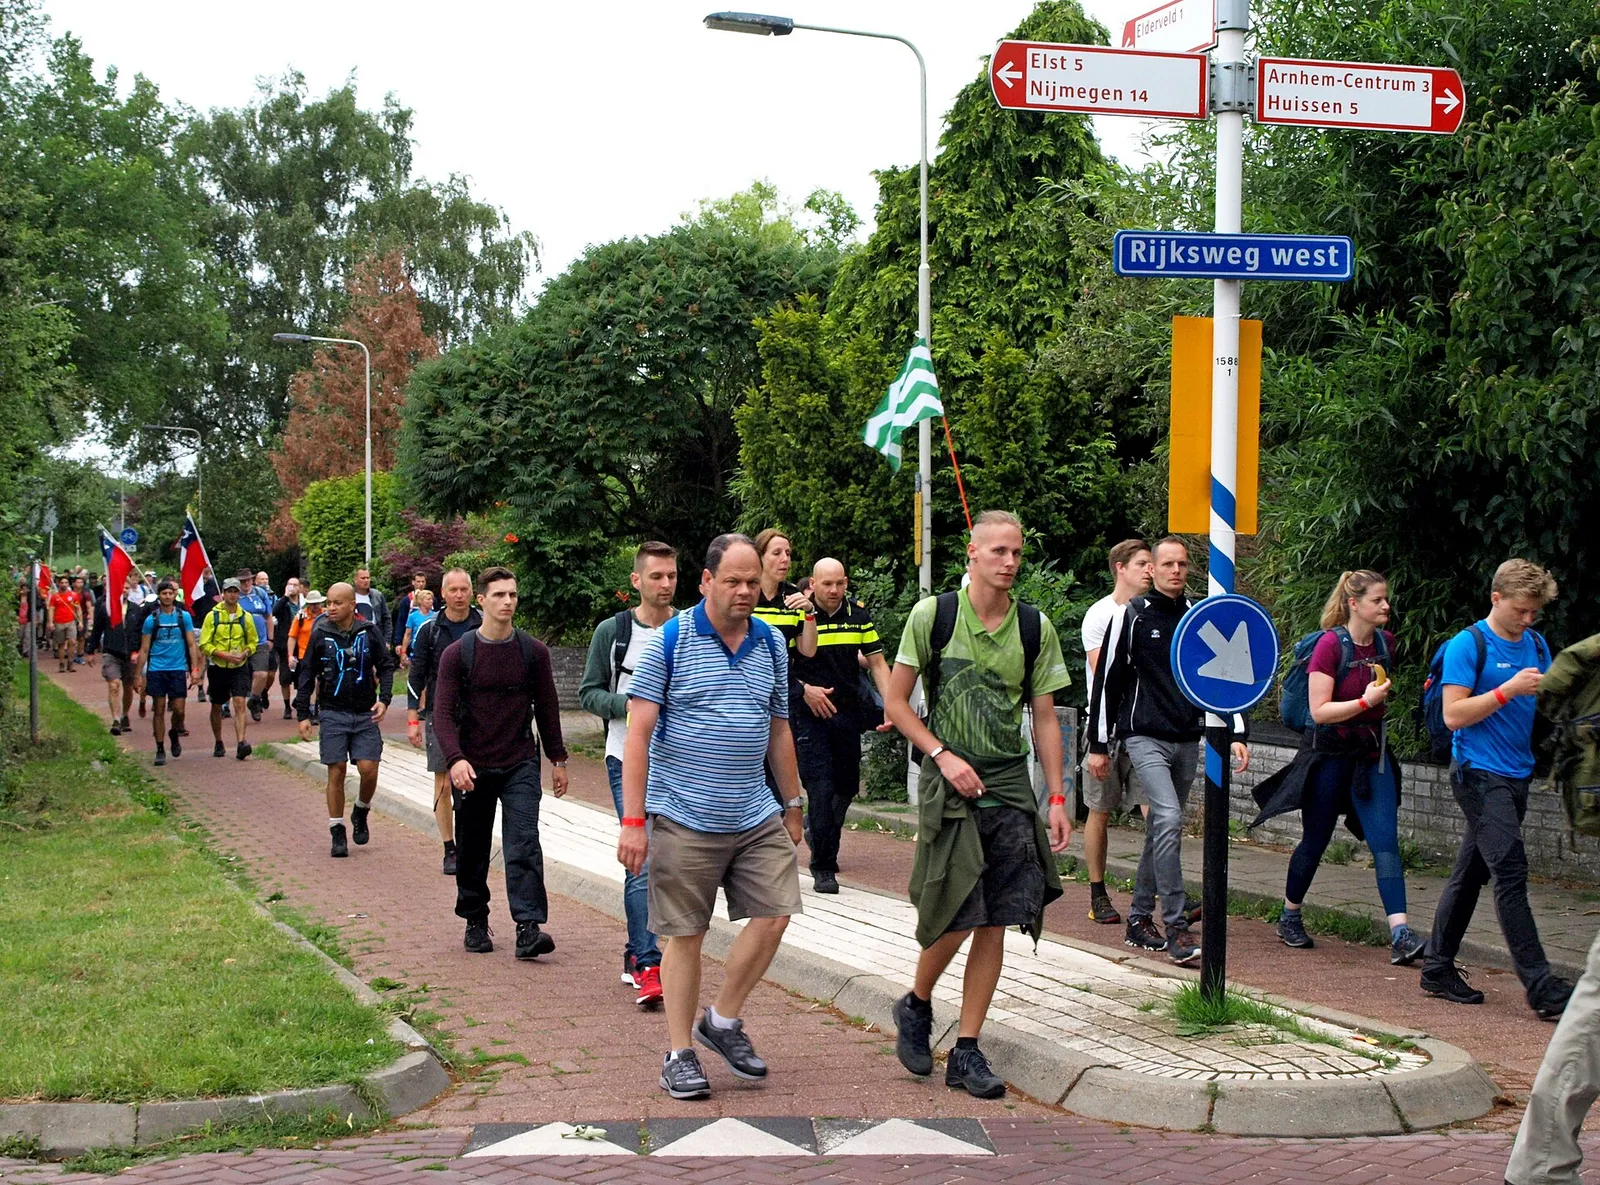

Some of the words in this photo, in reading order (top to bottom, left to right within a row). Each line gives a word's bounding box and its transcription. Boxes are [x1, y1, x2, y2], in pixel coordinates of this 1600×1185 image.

[1136, 10, 1177, 38] Elderveld
[1179, 9, 1184, 20] 1
[1031, 53, 1067, 70] Elst
[1074, 58, 1083, 71] 5
[1268, 69, 1416, 92] Arnhem-Centrum
[1421, 80, 1430, 92] 3
[1030, 80, 1123, 103] Nijmegen
[1130, 90, 1148, 102] 14
[1268, 95, 1342, 114] Huissen
[1350, 103, 1358, 115] 5
[1130, 239, 1259, 271] Rijksweg
[1271, 245, 1339, 267] west
[1216, 356, 1239, 366] 1588
[1227, 368, 1232, 377] 1
